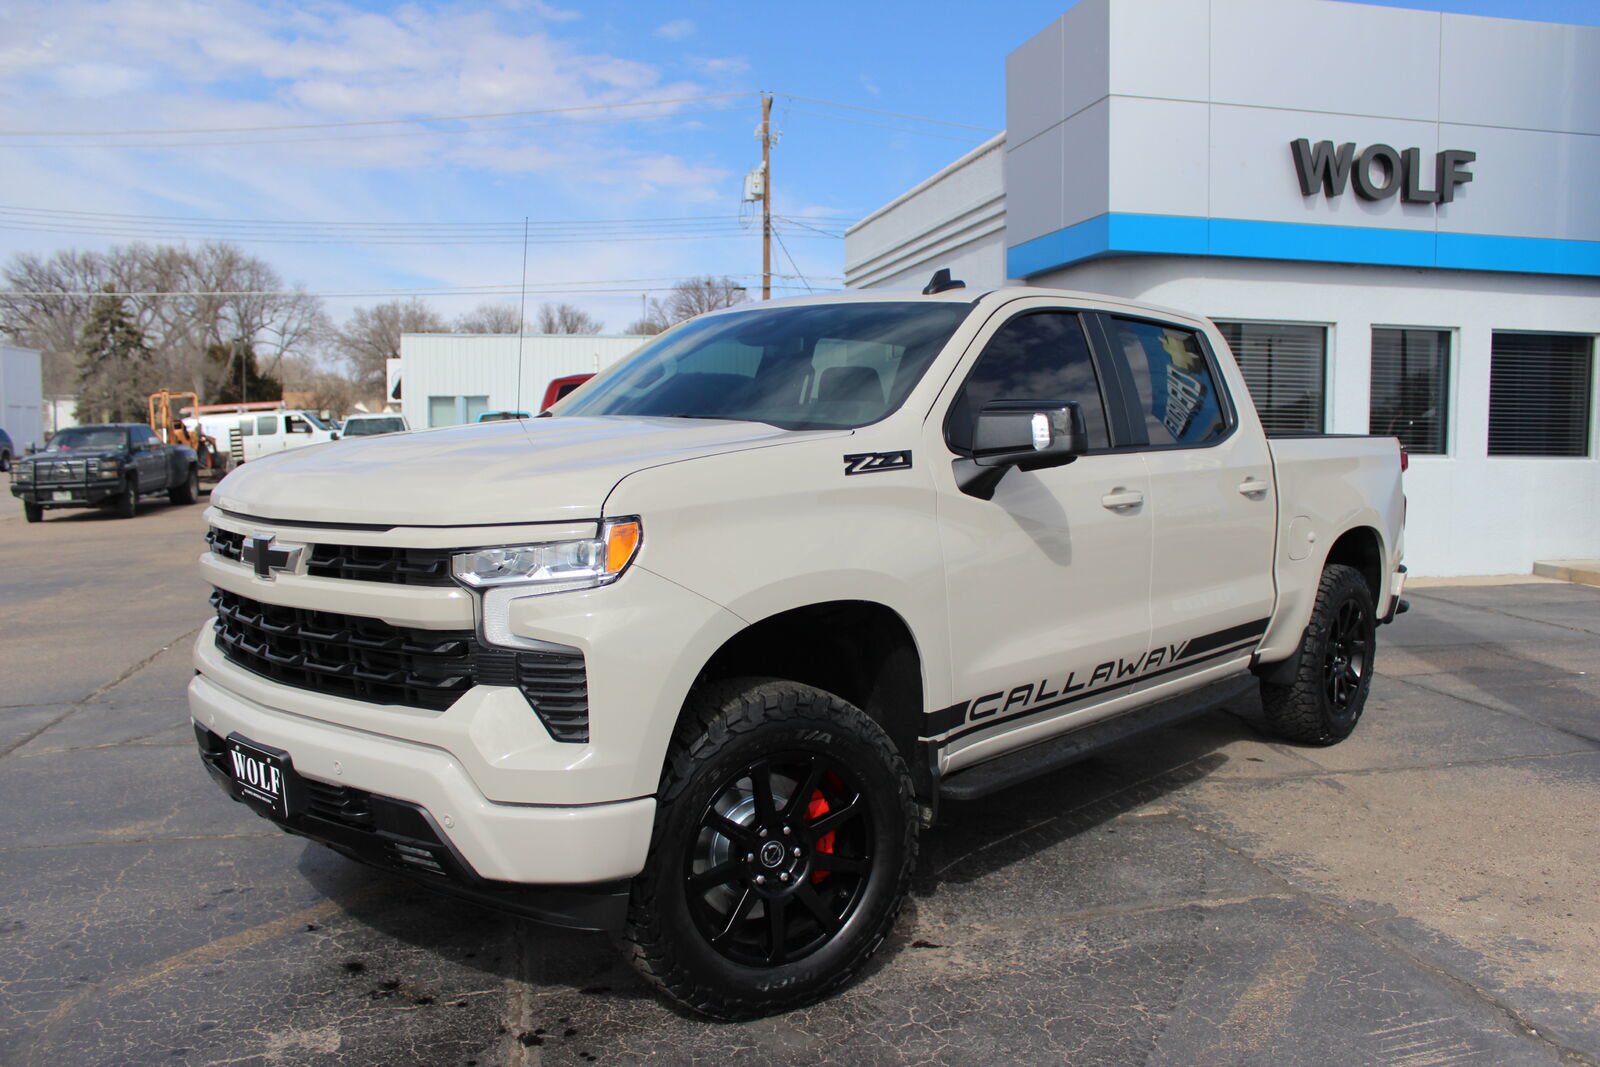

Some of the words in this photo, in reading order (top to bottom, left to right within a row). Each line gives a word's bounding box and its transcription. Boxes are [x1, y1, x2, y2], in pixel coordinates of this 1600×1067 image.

[1290, 138, 1476, 205] WOLF
[843, 449, 913, 476] Z71
[969, 639, 1188, 721] CALLAWAY
[230, 749, 281, 795] WOLF
